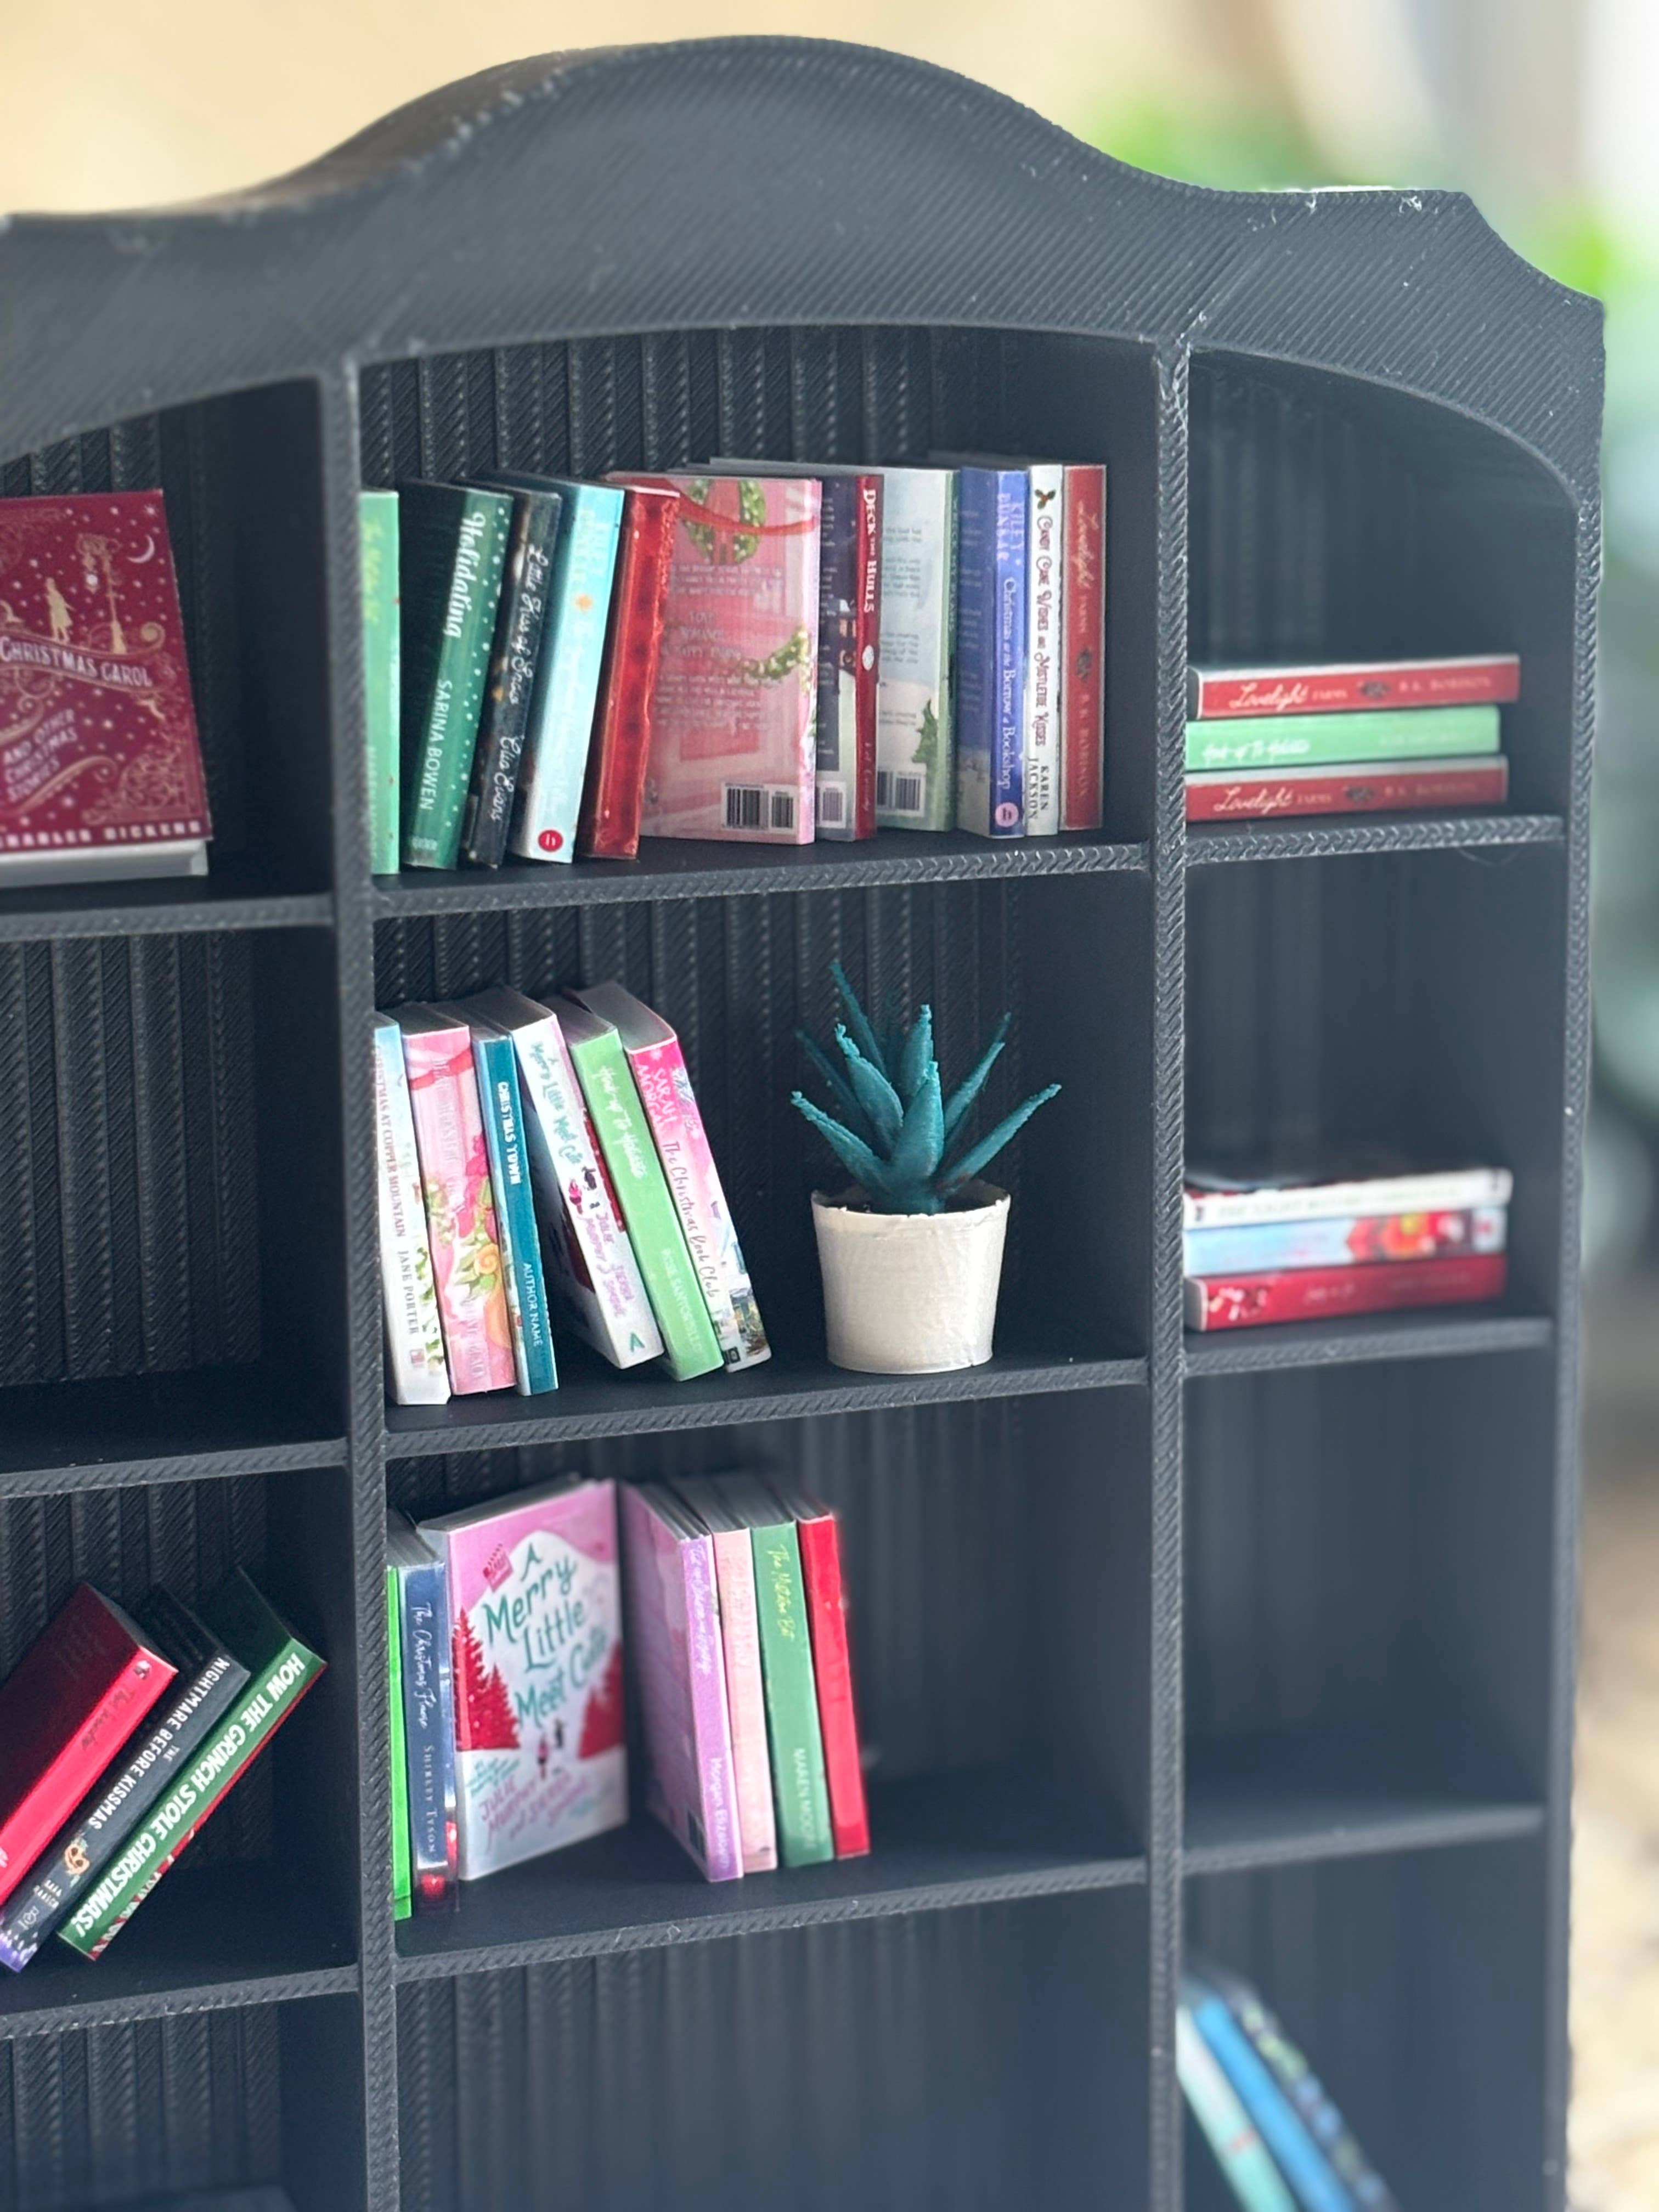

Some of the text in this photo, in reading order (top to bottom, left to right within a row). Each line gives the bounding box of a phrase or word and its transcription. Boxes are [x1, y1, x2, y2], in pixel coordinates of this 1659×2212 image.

[445, 512, 487, 639] Holidating
[1002, 577, 1018, 640] Christmas
[0, 636, 153, 686] CHRISTMAS CAROL
[1001, 669, 1015, 714] Borrow
[431, 679, 454, 742] SARINA
[1229, 682, 1309, 714] Lovelight
[420, 747, 443, 811] BOWEN
[997, 726, 1015, 789] Bookshop
[1026, 757, 1039, 820] JACKSON
[1039, 766, 1049, 811] KAREN
[1213, 786, 1294, 818] Lovelight
[381, 1113, 392, 1128] AT
[498, 1082, 517, 1143] CHRISTMAS
[652, 1068, 679, 1125] SARAH
[382, 1129, 399, 1173] COPPER
[388, 1175, 406, 1238] MOUNTAIN
[662, 1141, 721, 1300] The Christmas Book Club
[397, 1249, 419, 1335] JANE PORTER
[523, 1263, 544, 1347] AUTHOR NAME
[411, 1602, 433, 1626] The
[481, 1556, 577, 1645] Merry
[413, 1630, 433, 1688] Christmas
[524, 1600, 585, 1674] Little
[167, 1658, 230, 1731] NIGHTMARE
[514, 1666, 567, 1731] Meet
[130, 1729, 173, 1778] BEFORE
[71, 1653, 306, 1938] HOW THE GRINCH STOLE CHRISTMAS!
[88, 1775, 137, 1830] KISSMAS
[424, 1746, 438, 1853] SHIRLEY TYSON
